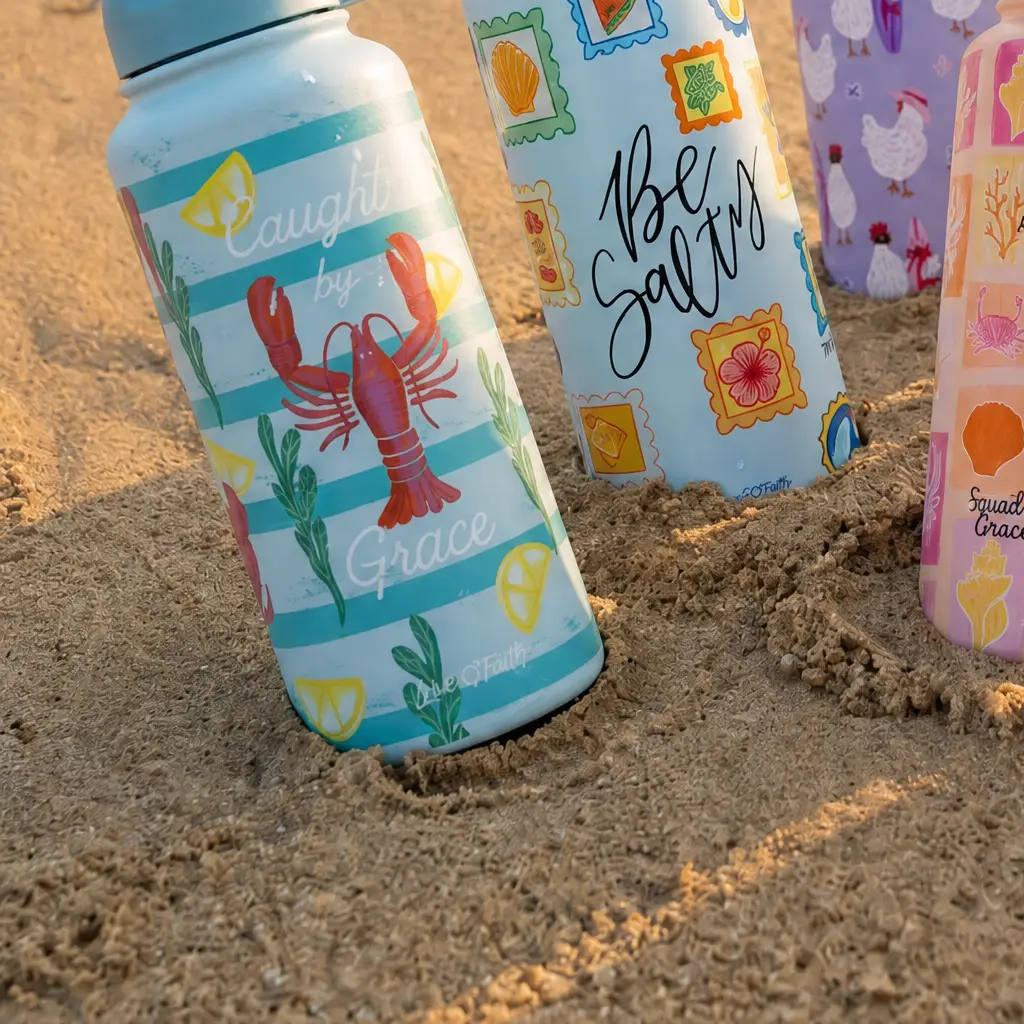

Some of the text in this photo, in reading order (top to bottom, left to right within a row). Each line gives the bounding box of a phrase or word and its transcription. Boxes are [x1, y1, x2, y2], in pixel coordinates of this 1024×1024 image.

[225, 150, 391, 258] Caught
[599, 124, 717, 263] Be
[313, 256, 361, 308] by
[346, 511, 496, 601] Grace
